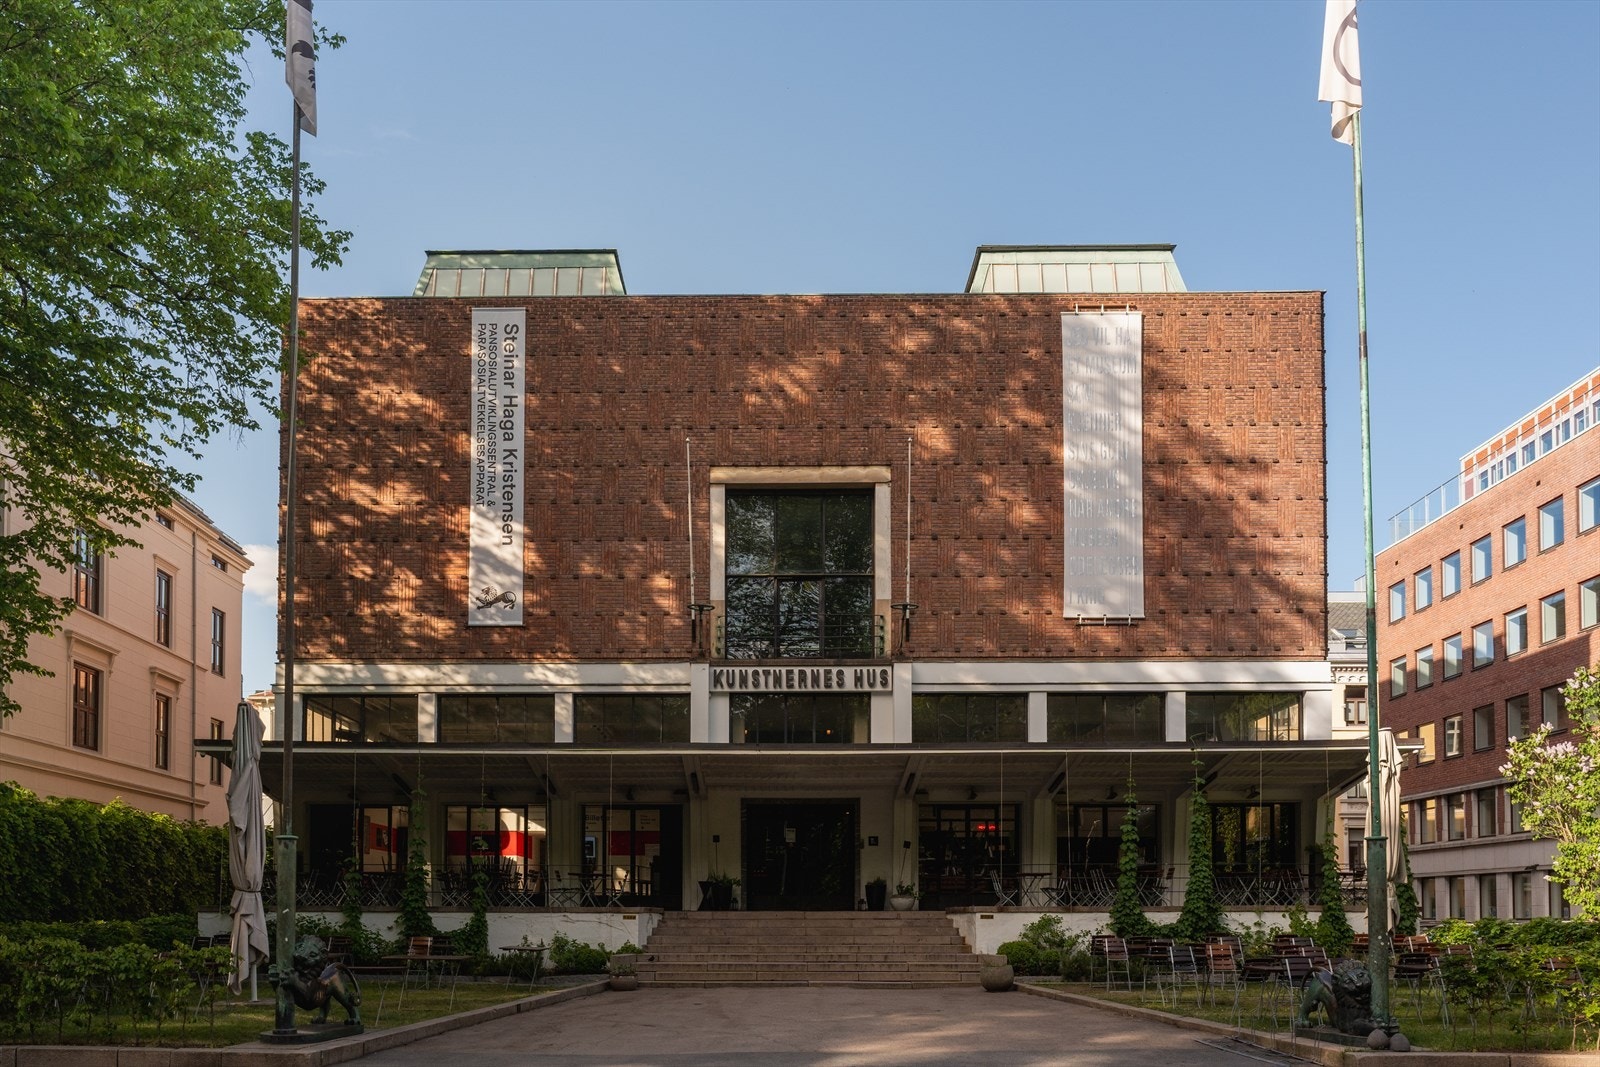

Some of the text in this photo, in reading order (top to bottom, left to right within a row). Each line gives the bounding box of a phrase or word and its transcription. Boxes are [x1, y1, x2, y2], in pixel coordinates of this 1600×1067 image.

[475, 323, 487, 507] PARASOSIALTVEKKELSESAPPARAT
[487, 323, 497, 496] PANSOSIALUTVIKLINGSSENTRAL
[1093, 327, 1111, 346] VIL
[1115, 327, 1132, 346] HA
[499, 323, 519, 546] Steinar Haga Kristensen
[713, 668, 890, 689] KUNSTNERNES HUS
